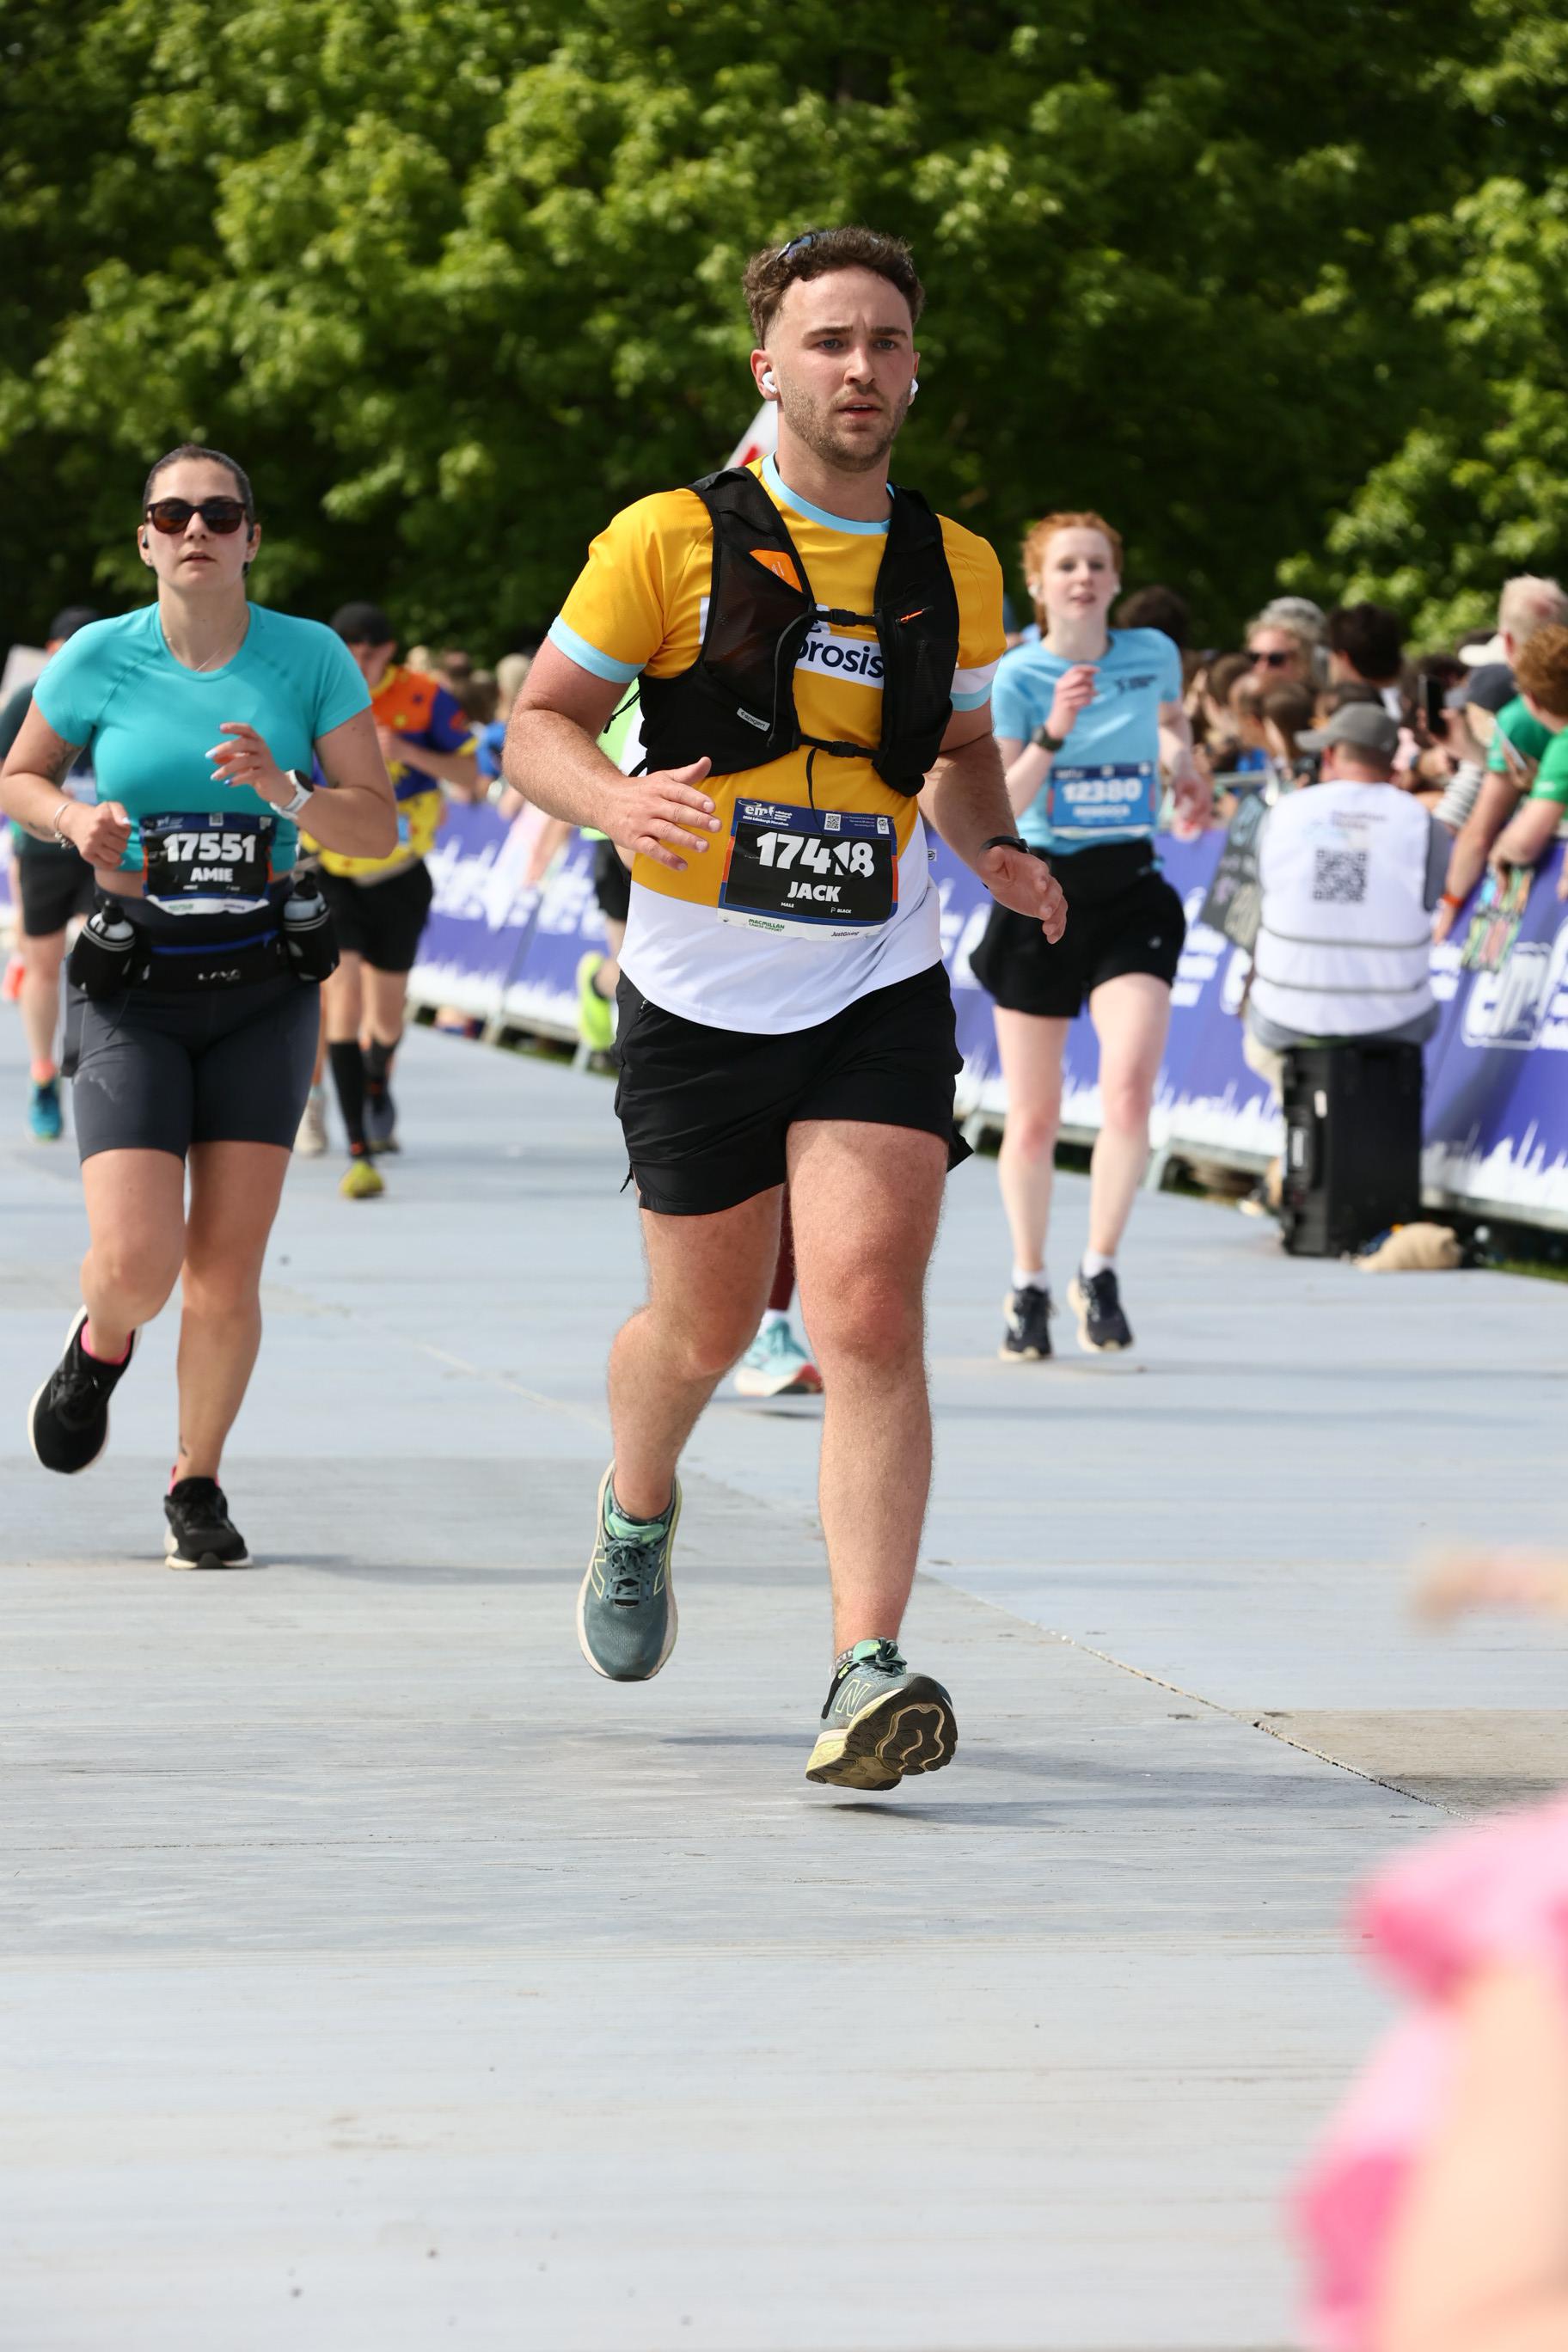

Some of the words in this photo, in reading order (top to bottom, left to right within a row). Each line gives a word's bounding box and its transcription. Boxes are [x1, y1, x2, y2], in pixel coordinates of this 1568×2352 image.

[162, 832, 256, 863] 17551
[756, 831, 875, 878] 17418
[190, 867, 233, 883] AMIE
[787, 881, 842, 903] JACK
[748, 918, 785, 929] MACMILLAN
